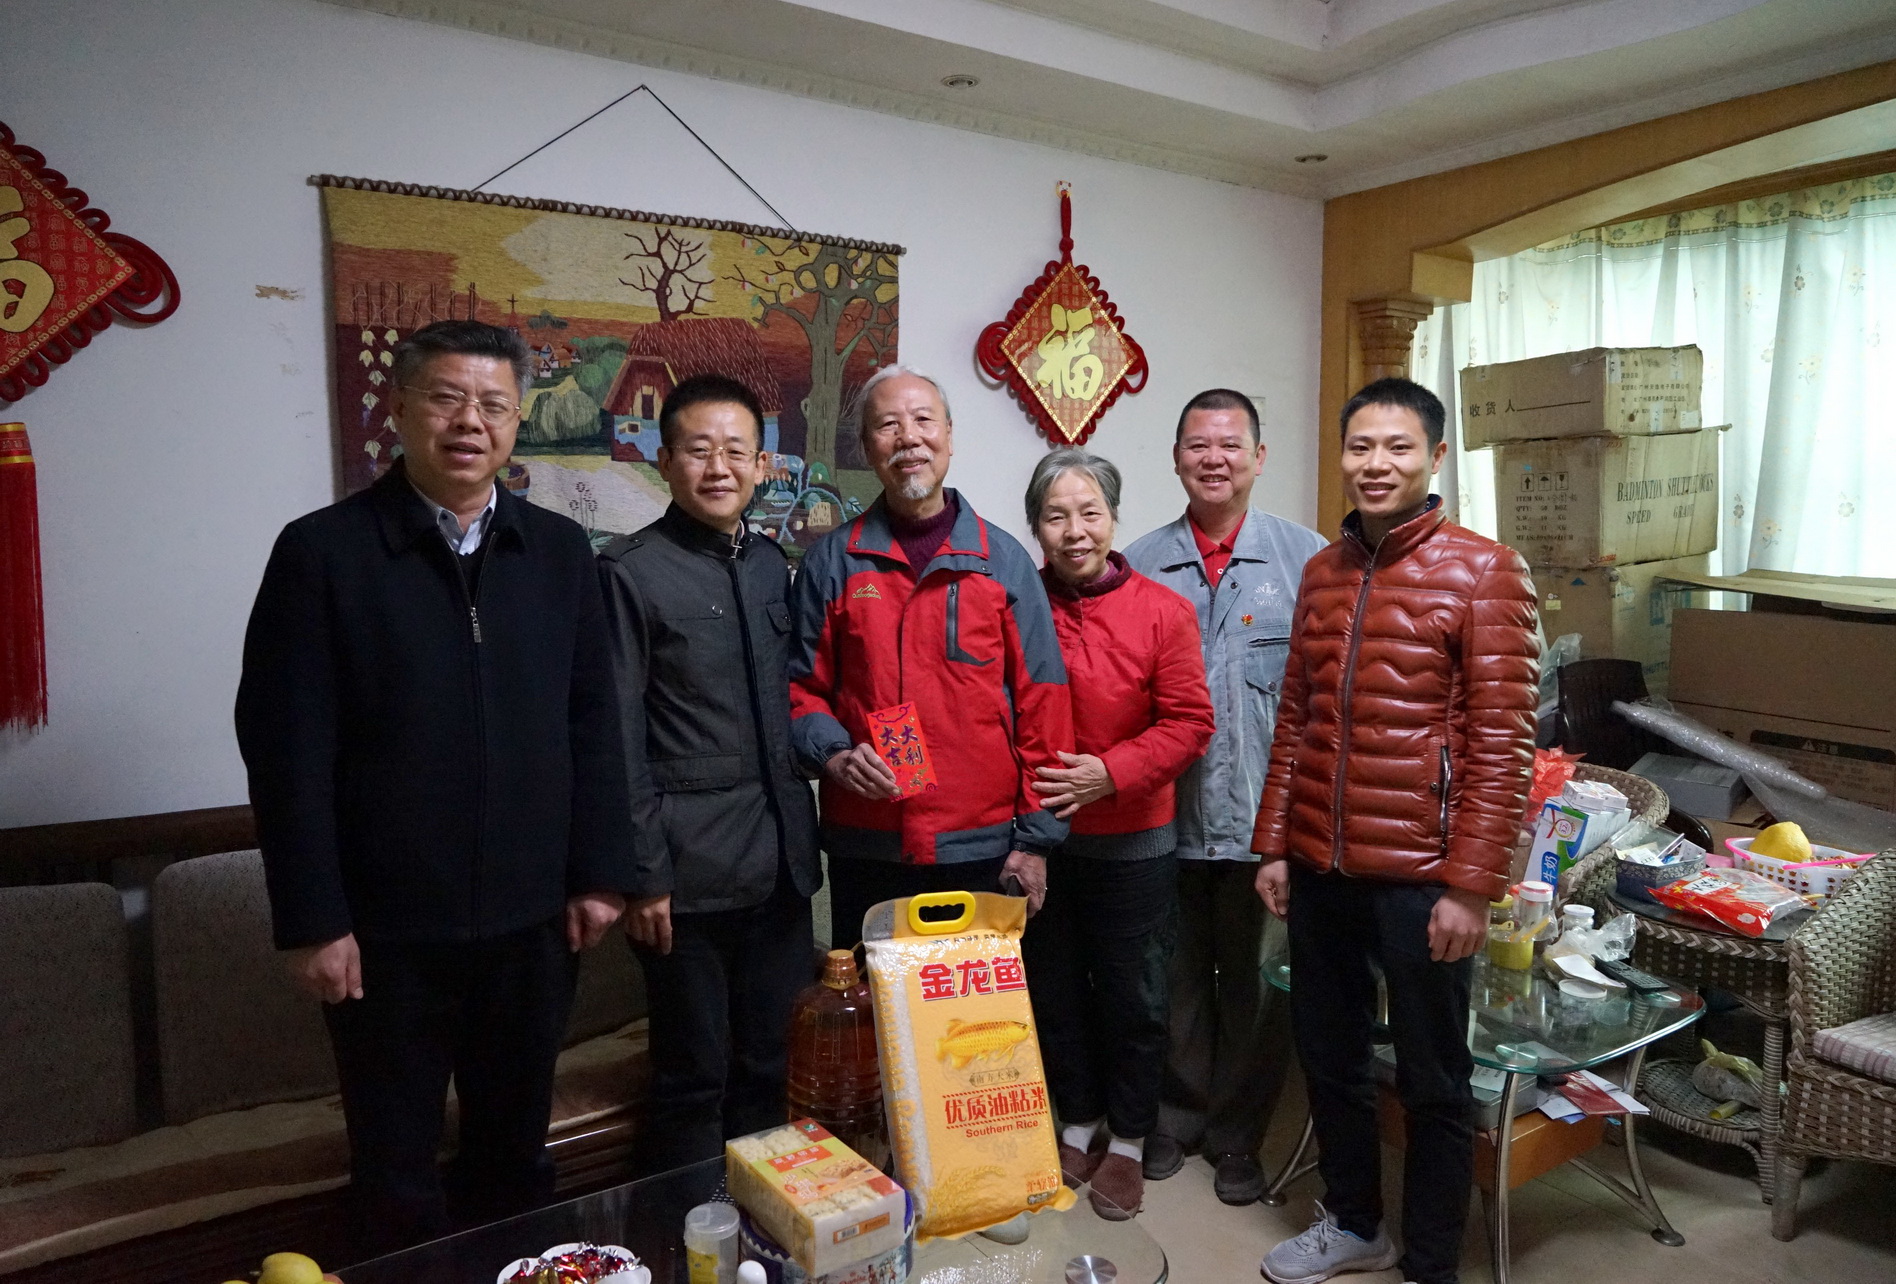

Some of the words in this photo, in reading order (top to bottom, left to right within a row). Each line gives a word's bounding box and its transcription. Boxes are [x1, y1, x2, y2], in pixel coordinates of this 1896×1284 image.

[1036, 303, 1105, 401] 福
[1469, 399, 1516, 417] 收货人
[1617, 479, 1663, 502] BADMINTON
[1626, 509, 1651, 525] SPEED
[1543, 855, 1558, 883] 牛奶
[918, 956, 1027, 1002] 金龙鱼
[944, 1086, 1047, 1125] 优质油粘米
[965, 1124, 1014, 1138] Southern
[1016, 1119, 1039, 1130] Rice
